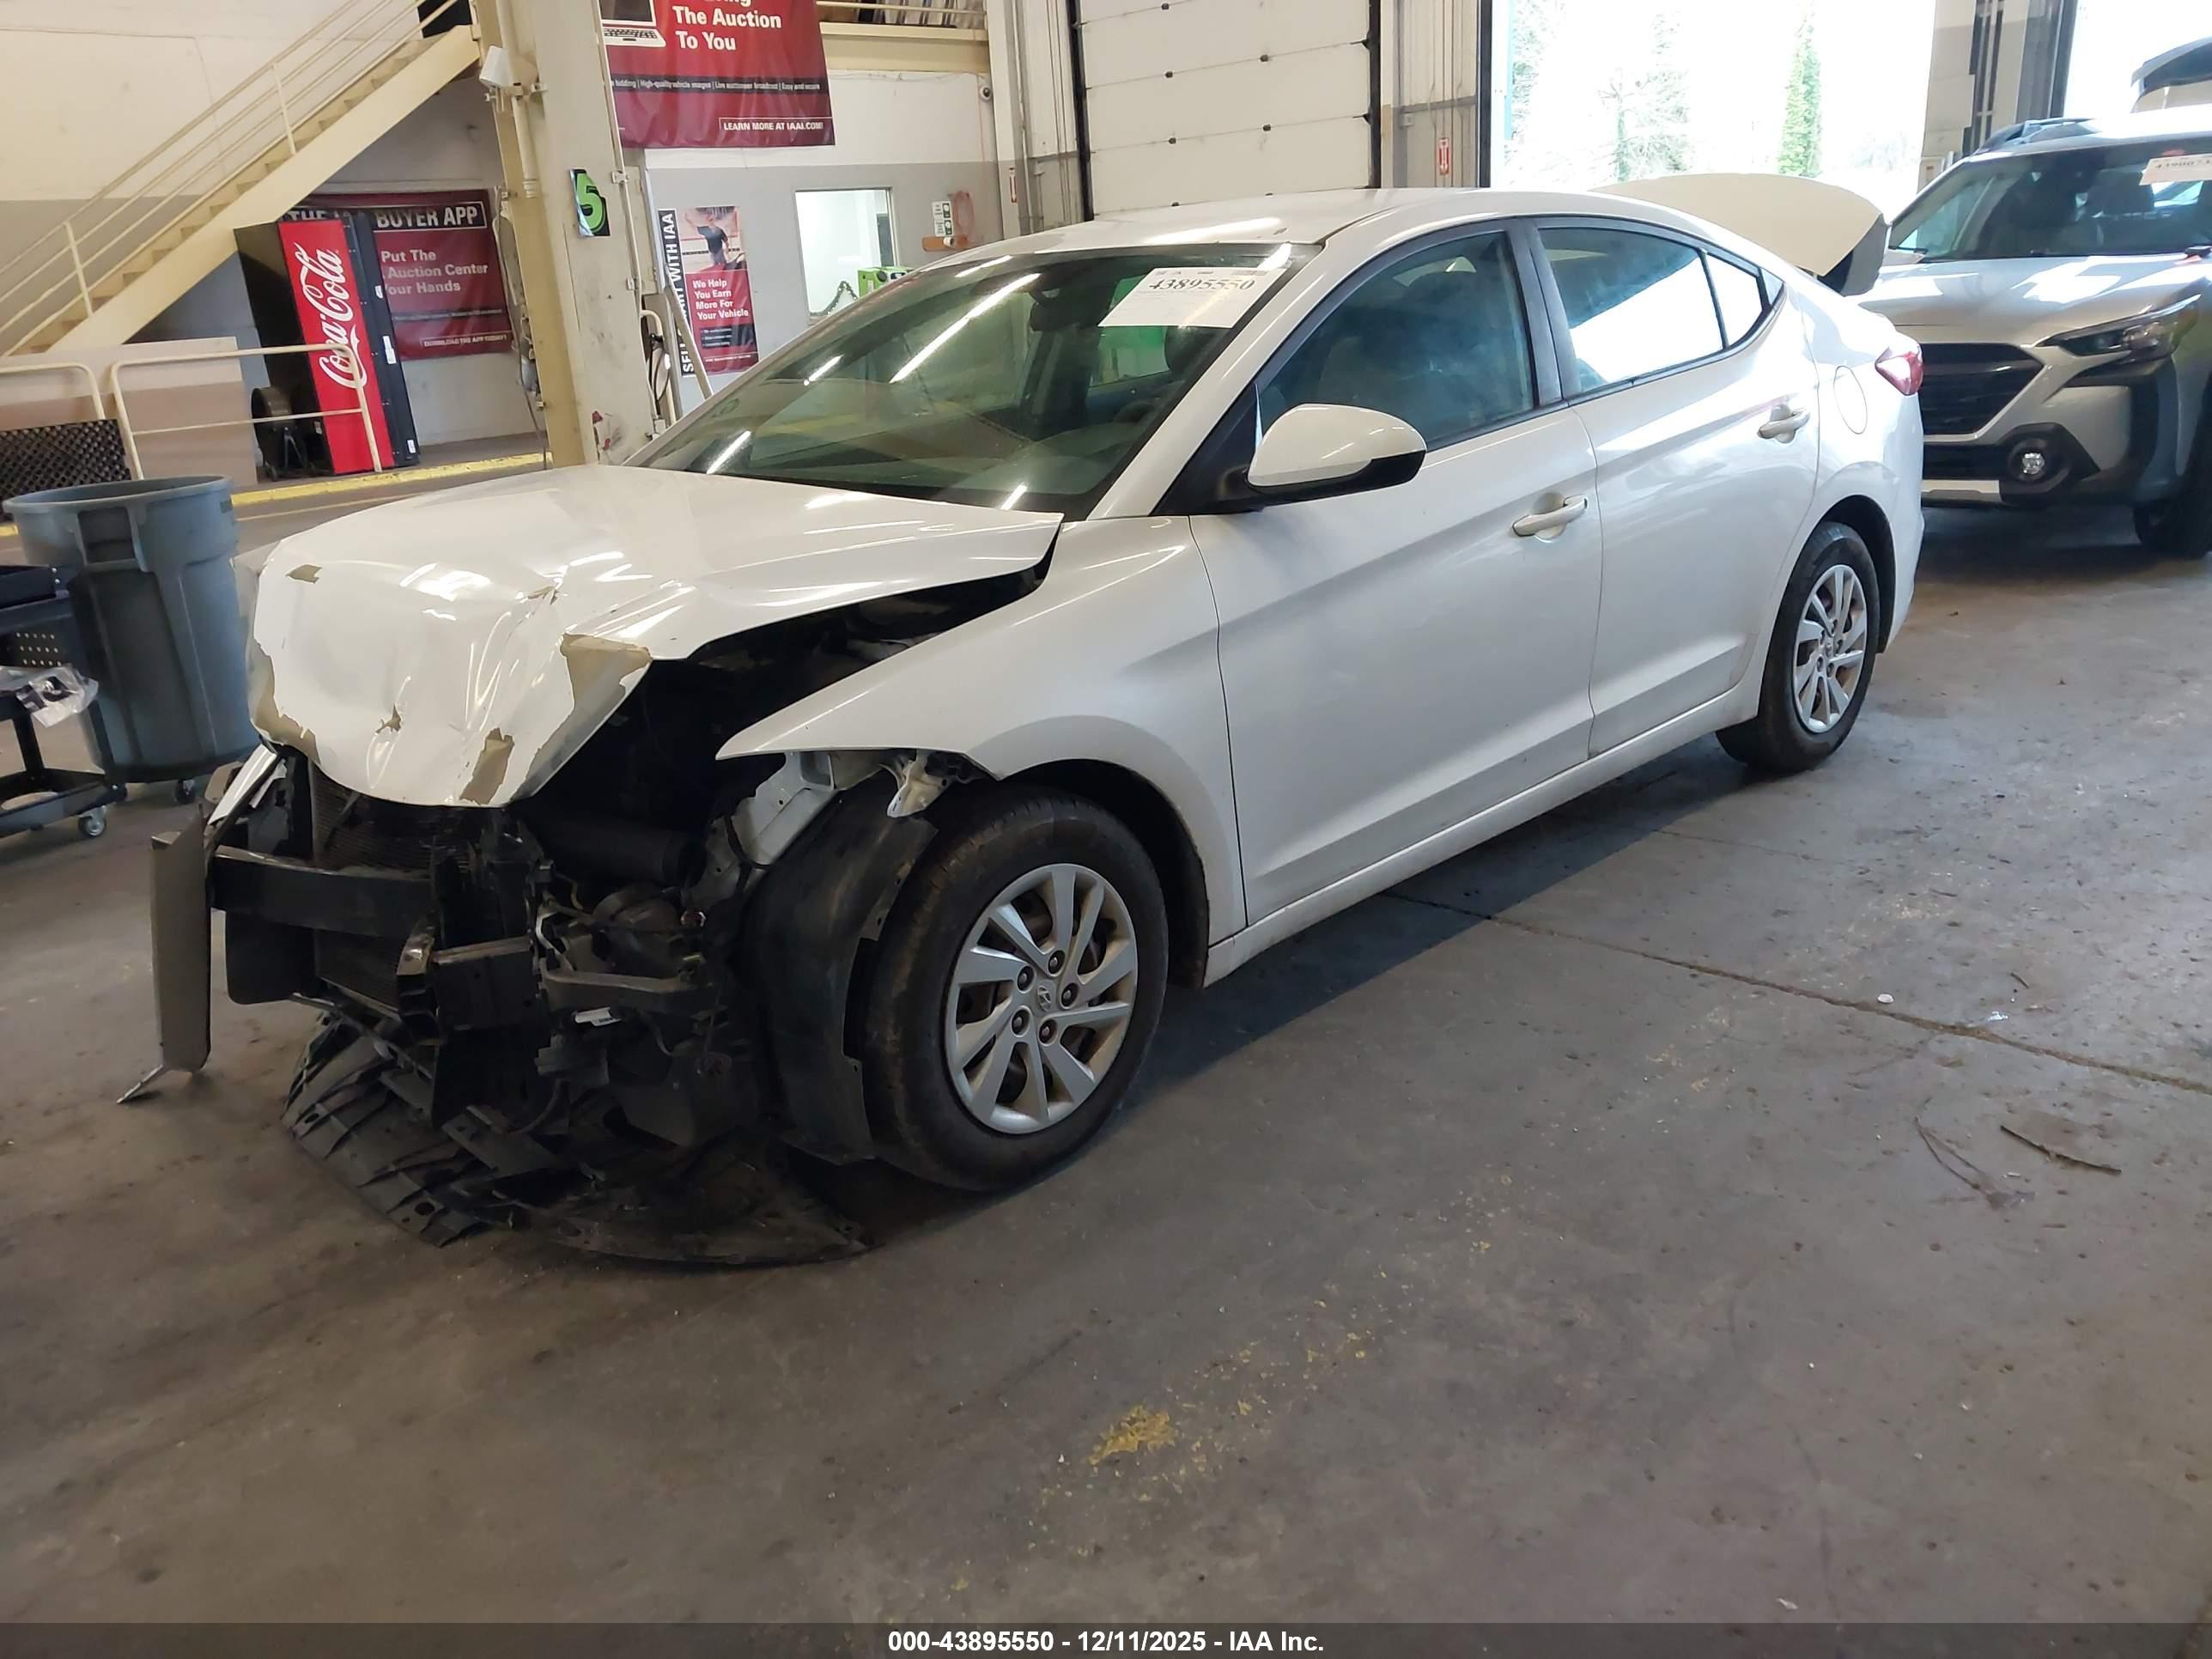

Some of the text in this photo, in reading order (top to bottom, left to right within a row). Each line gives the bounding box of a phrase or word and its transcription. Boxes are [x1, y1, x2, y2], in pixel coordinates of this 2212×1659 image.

[673, 6, 781, 28] The Auction
[676, 30, 736, 50] To You
[724, 122, 750, 131] LEARN
[775, 122, 785, 131] AT
[576, 173, 604, 231] 5
[375, 209, 439, 228] BUYER
[443, 206, 478, 226] APP
[662, 213, 676, 240] IAA
[380, 249, 436, 263] Put The
[665, 243, 682, 282] WITH
[388, 264, 488, 279] Auction Center
[416, 280, 461, 294] Hands
[693, 278, 726, 289] We Help
[695, 289, 732, 300] You Earn
[696, 300, 733, 310] More For
[696, 308, 749, 321] Your Vehicle
